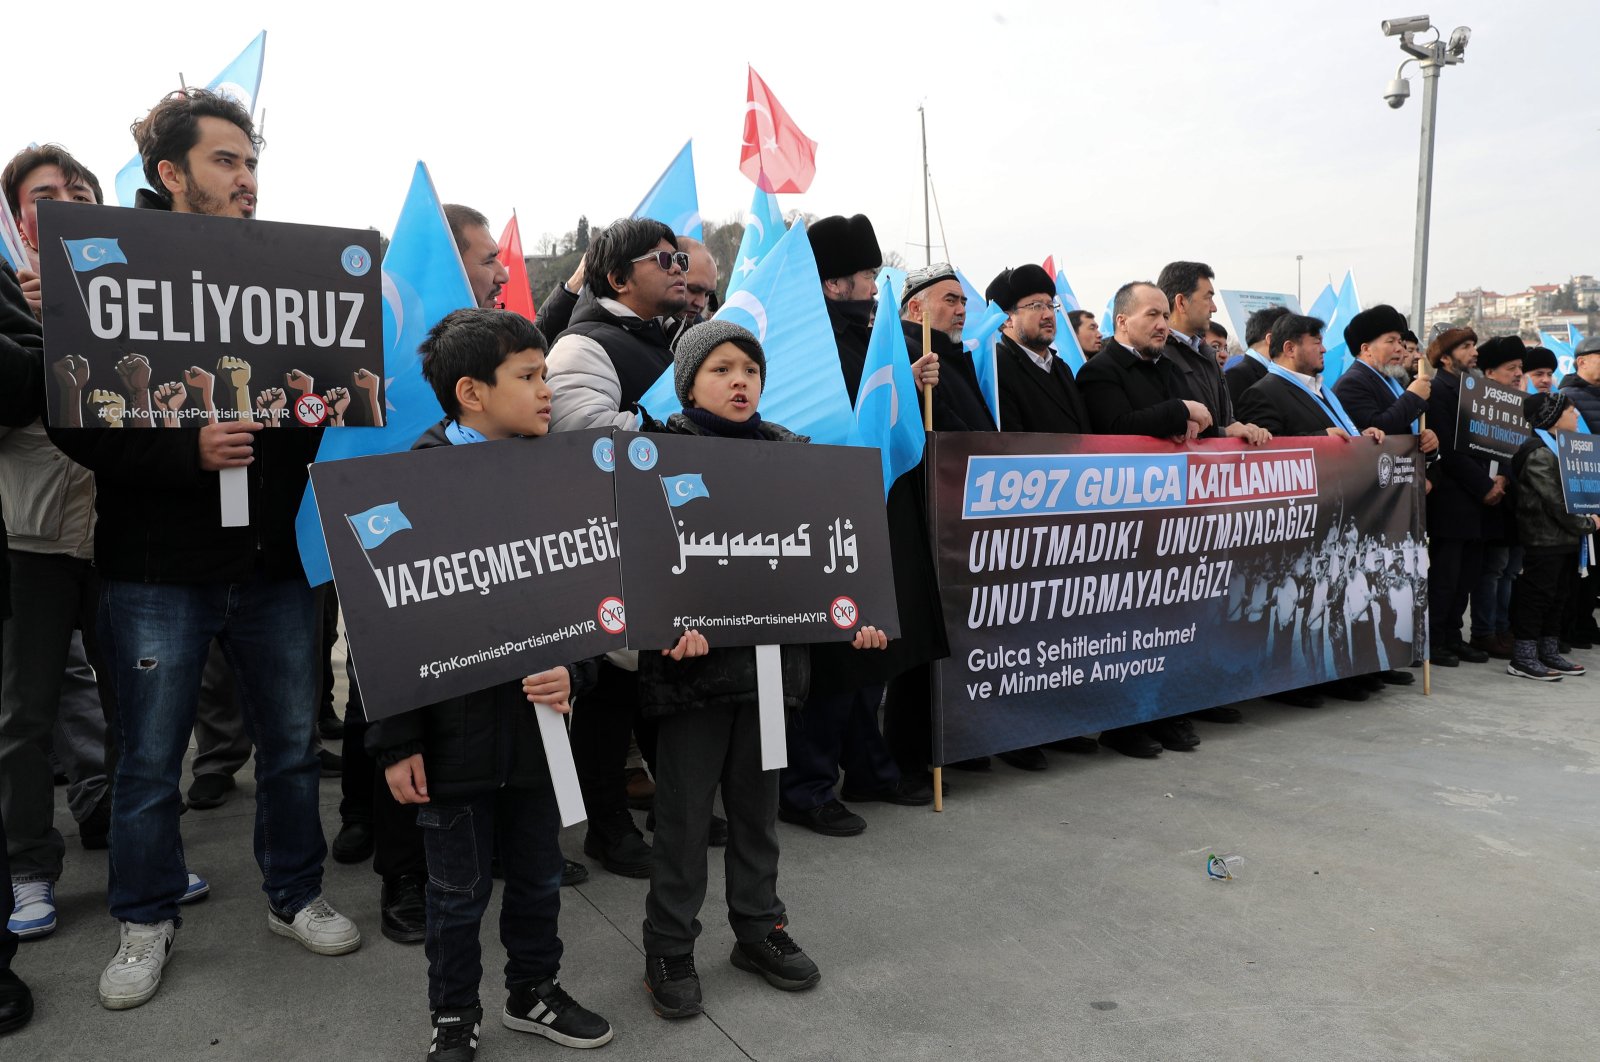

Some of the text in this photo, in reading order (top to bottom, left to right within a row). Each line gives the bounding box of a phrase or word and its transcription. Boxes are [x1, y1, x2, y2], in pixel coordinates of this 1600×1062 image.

[88, 270, 366, 348] GELİYORUZ
[298, 402, 324, 418] ÇKP
[1483, 386, 1522, 406] yaşasın
[97, 407, 290, 421] #ÇinKoministPartisineHAYIR
[1469, 419, 1489, 437] DOĞU
[970, 452, 1315, 511] 1997 GULCA KATLİAMINI
[968, 499, 1318, 574] UNUTMADIK! UNUTMAYACAĞIZ!
[967, 556, 1233, 630] UNUTTURMAYACAĞIZ!
[601, 606, 624, 626] ÇKP
[673, 612, 828, 631] #ÇinKoministPartisineHAYIR
[833, 605, 855, 621] ÇKP
[419, 619, 597, 679] #ÇinKoministPartisineHAYIR
[967, 622, 1197, 672] Gulca Şehitlerini Rahmet
[966, 656, 1166, 701] ve Minnetle Anıyoruz
